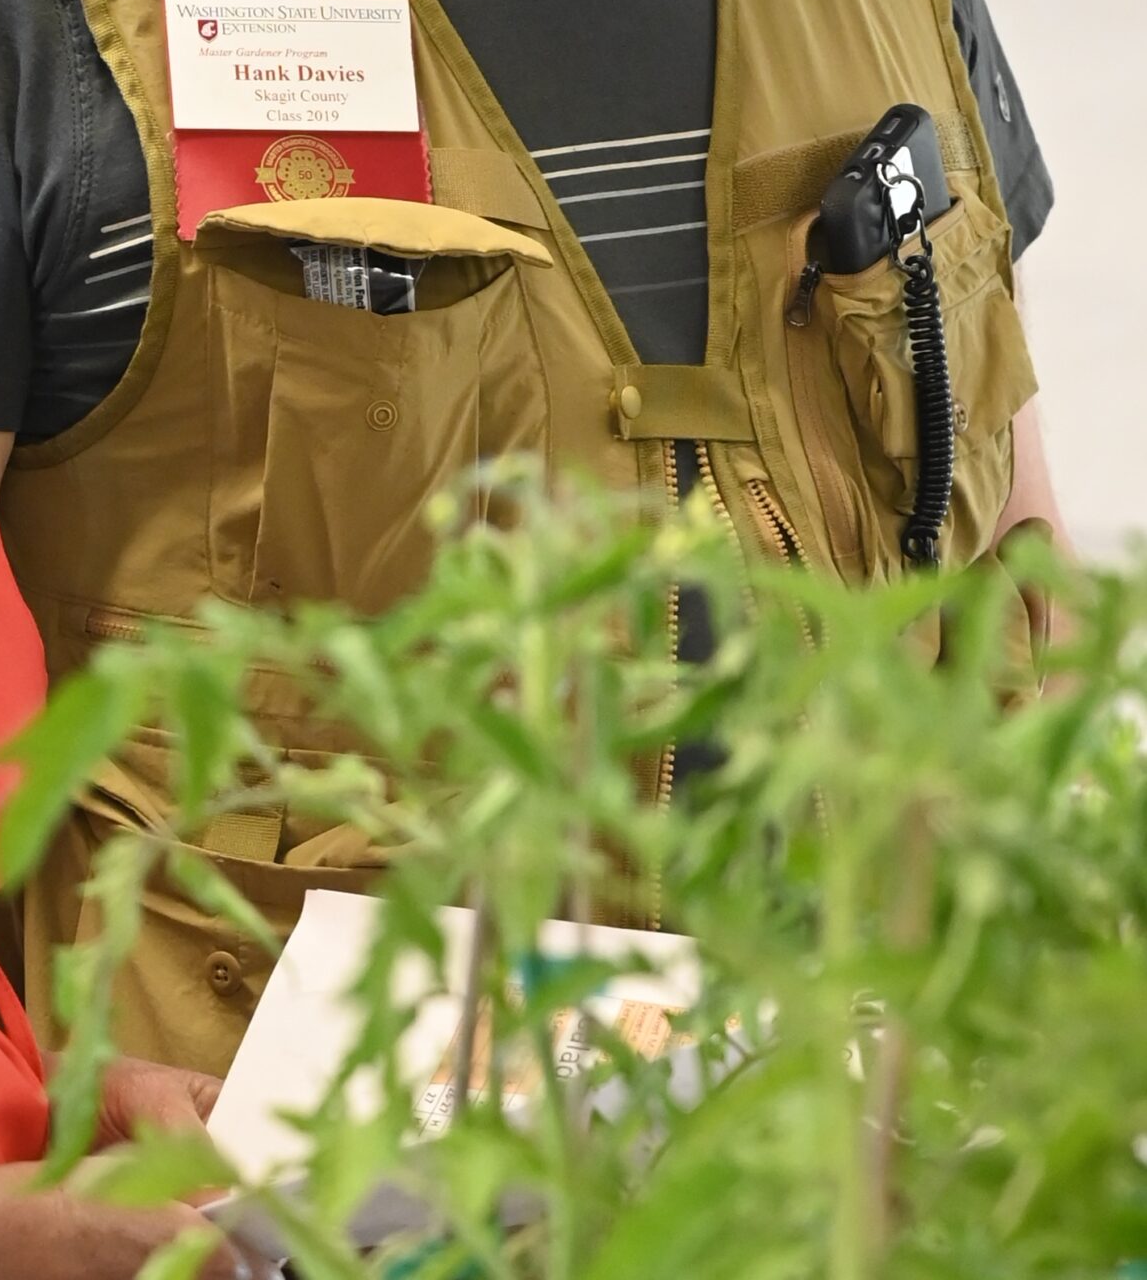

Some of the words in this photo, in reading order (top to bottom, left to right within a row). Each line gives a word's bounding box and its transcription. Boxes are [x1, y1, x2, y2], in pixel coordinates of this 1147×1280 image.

[177, 4, 274, 19] WASHINGTON
[278, 5, 317, 20] STATE
[320, 6, 402, 21] UNIVERSITY
[222, 23, 297, 35] EXTENSION
[199, 47, 232, 57] Master
[236, 47, 282, 58] Gardener
[285, 48, 328, 60] Program
[233, 64, 290, 82] Hank
[297, 64, 365, 82] Davies
[254, 89, 296, 105] Skagit
[300, 90, 348, 105] County
[266, 110, 302, 122] Class
[306, 111, 339, 122] 2019
[298, 170, 312, 180] 50
